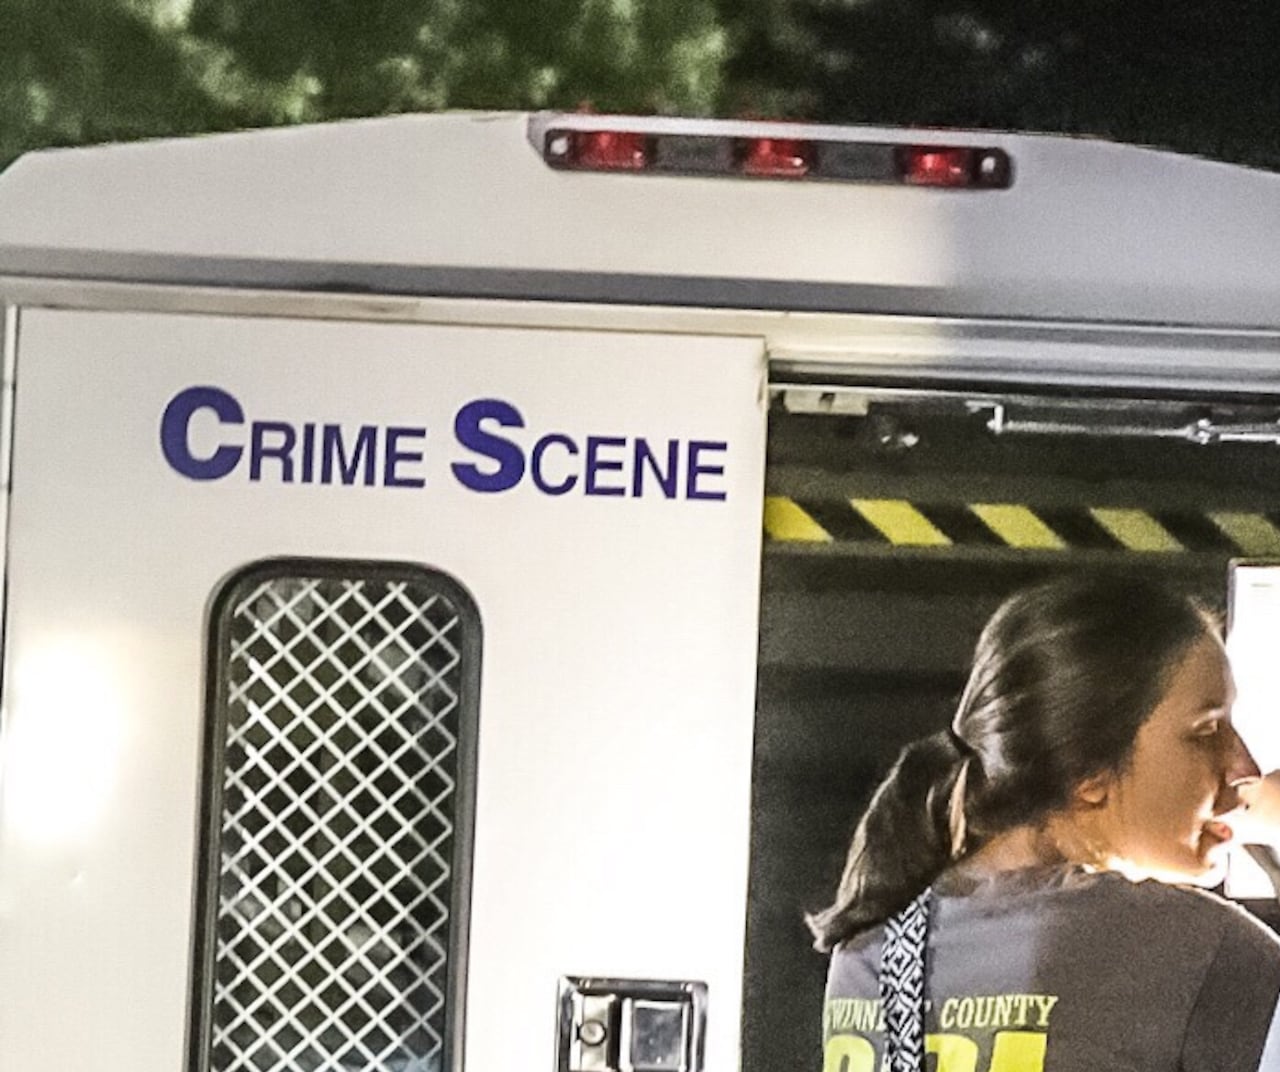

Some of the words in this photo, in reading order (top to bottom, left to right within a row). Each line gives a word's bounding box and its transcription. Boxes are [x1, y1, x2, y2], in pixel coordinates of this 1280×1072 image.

[160, 386, 427, 488] CRIME
[450, 398, 729, 501] SCENE
[939, 994, 1059, 1031] COUNTY
